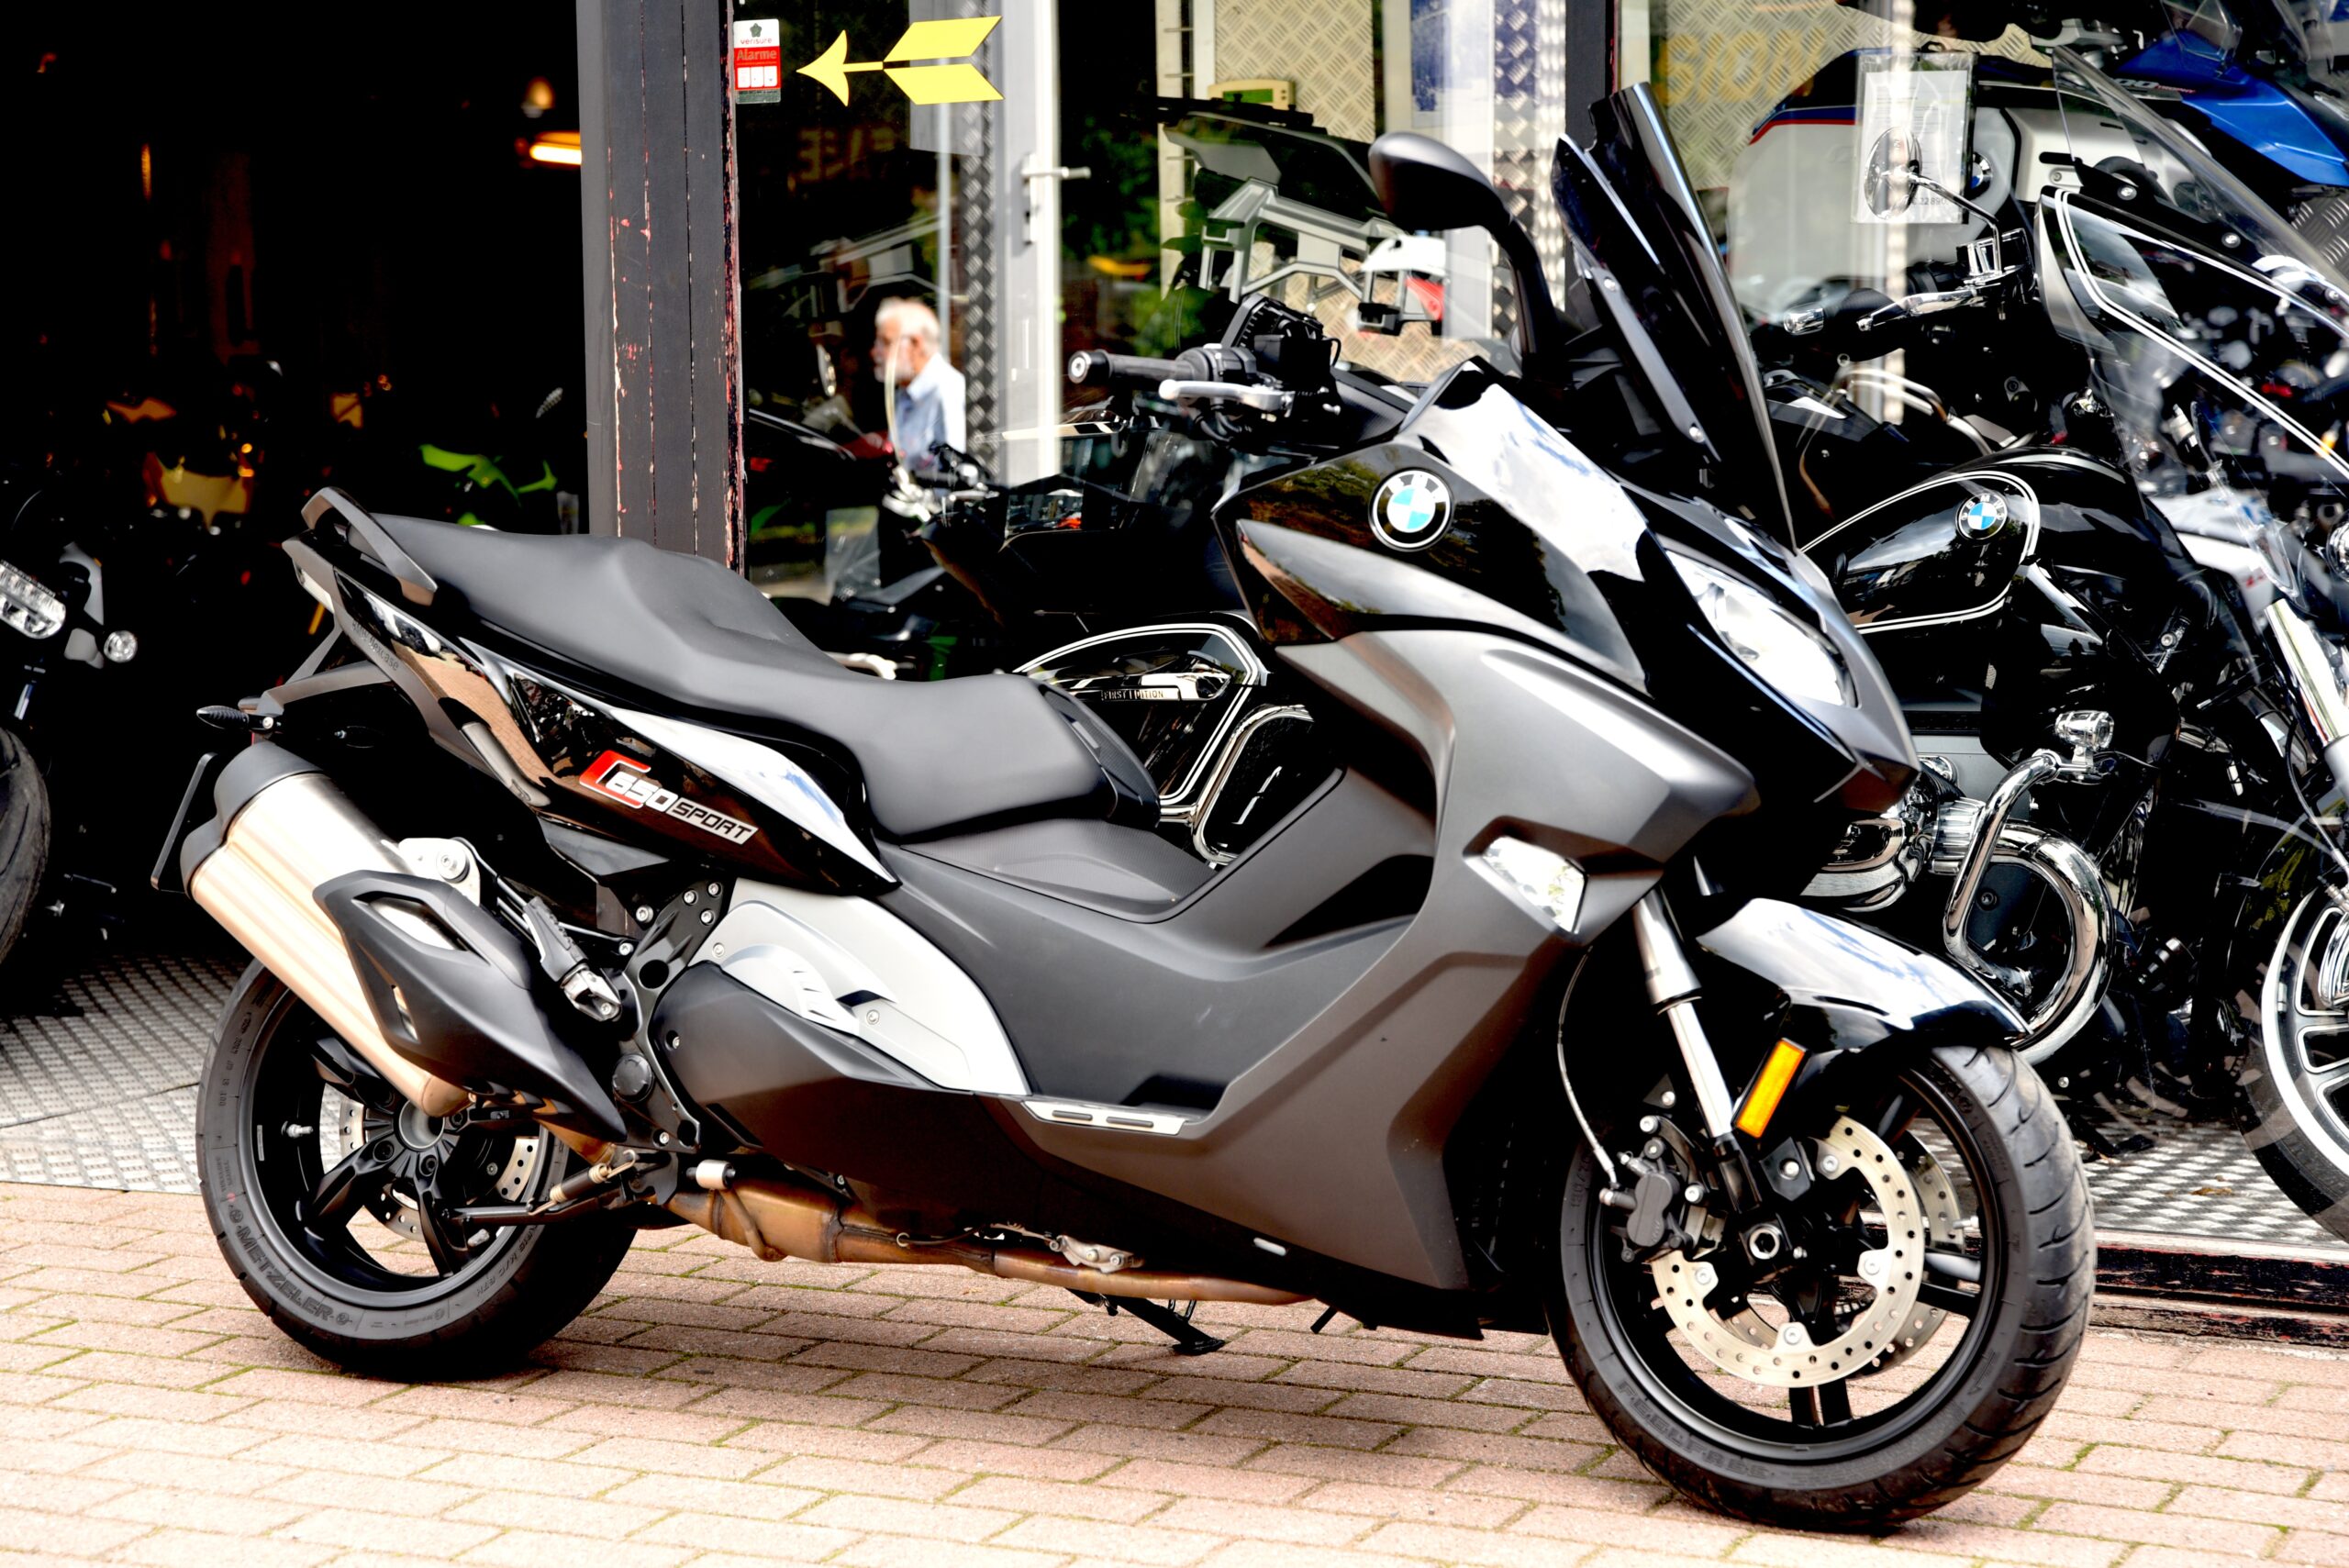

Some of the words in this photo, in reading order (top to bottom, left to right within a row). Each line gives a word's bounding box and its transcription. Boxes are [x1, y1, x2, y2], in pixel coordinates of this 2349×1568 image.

[737, 49, 777, 61] Alarme
[672, 801, 752, 840] SPORT
[236, 1226, 334, 1321] METZELER
